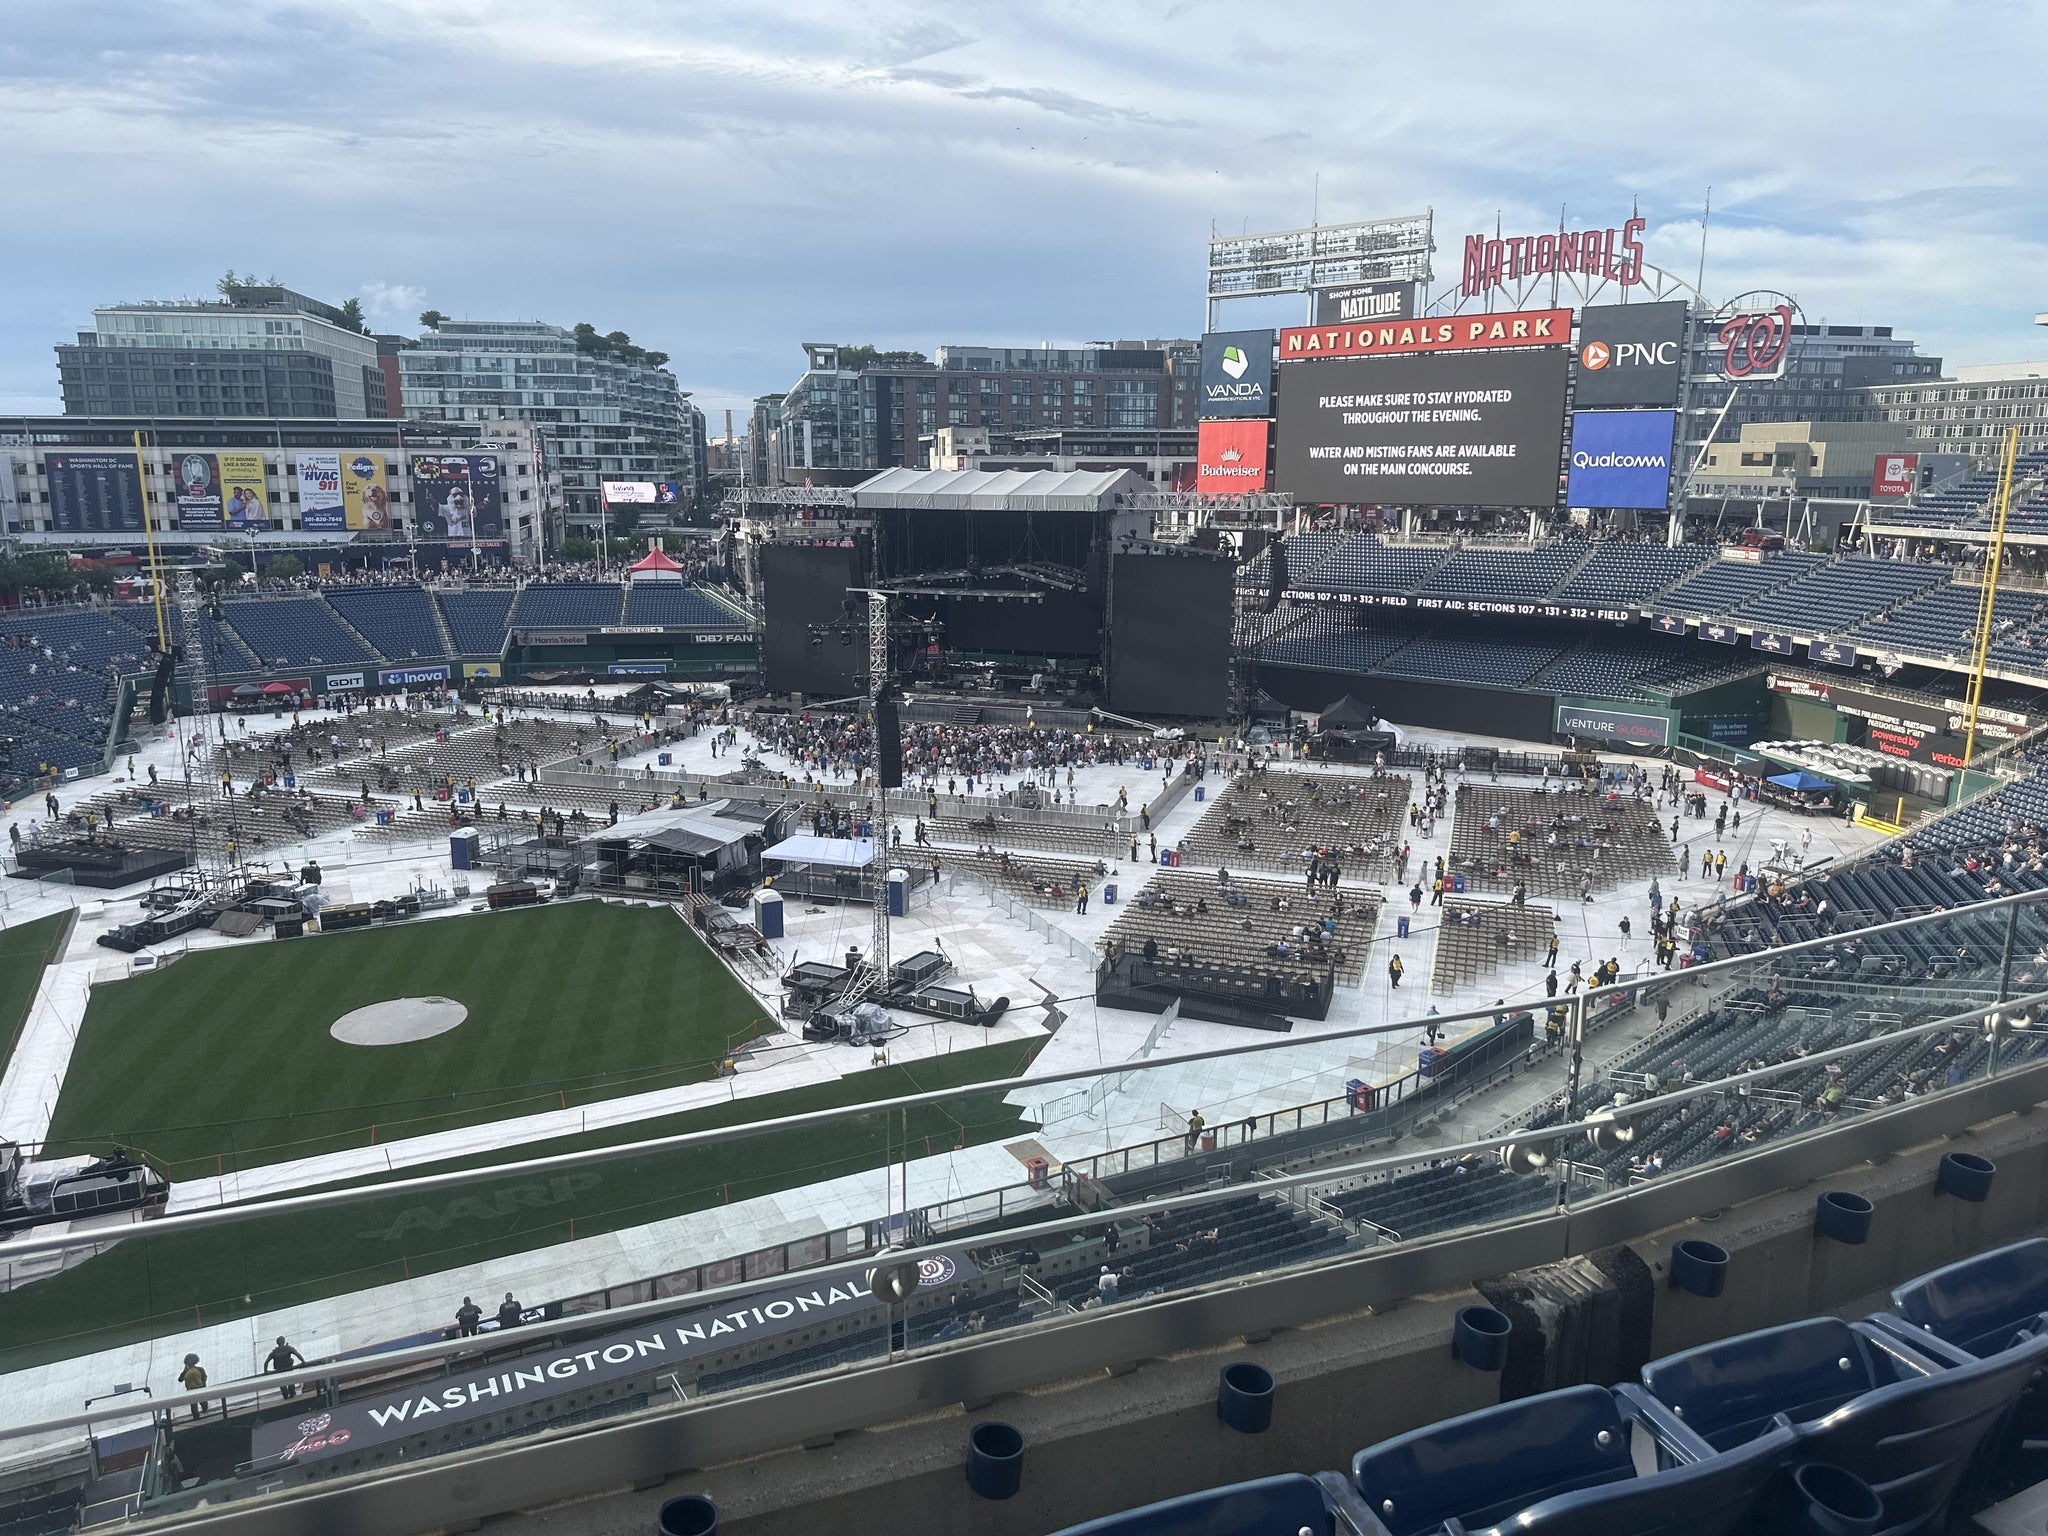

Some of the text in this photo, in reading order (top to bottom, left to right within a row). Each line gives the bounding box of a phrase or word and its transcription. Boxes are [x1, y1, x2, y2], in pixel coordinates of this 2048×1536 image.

[1462, 218, 1646, 297] NATIONALS
[1328, 286, 1373, 300] SHOW SOME
[1340, 291, 1401, 319] NATITUDE
[1288, 318, 1553, 351] NATIONALS PARK
[1614, 340, 1678, 366] PNC
[1206, 382, 1264, 396] VANDA
[1319, 390, 1511, 408] PLEASE MAKE SURE TO STAY HYDRATED
[1343, 409, 1481, 424] THROUGHOUT THE EVENING.
[1310, 445, 1516, 458] WATER AND MISTING FANS ARE AVAILABLE
[346, 463, 378, 471] Pedigree
[1574, 452, 1666, 469] Qualcomm
[305, 472, 338, 480] HVAC
[1201, 464, 1260, 476] Budweiser
[1344, 463, 1472, 475] ON THE MAIN CONCOURSE.
[318, 481, 338, 490] 911
[613, 484, 634, 496] living
[1281, 592, 1407, 606] ECTIONS 107 131 312 FIELD
[1417, 599, 1628, 620] FIRST AID: SECTIONS 107 131 312 FIELD
[726, 634, 752, 642] FAN
[329, 677, 363, 687] GDIT
[404, 671, 442, 683] Inova
[1777, 680, 1810, 689] WASHINGTON
[1790, 687, 1819, 696] NATIONALS
[1994, 710, 2009, 719] EXIT
[1565, 718, 1660, 737] VENTURE GLOBAL
[1872, 730, 1920, 748] powered by
[1879, 741, 1910, 757] Verizon
[368, 1281, 872, 1428] WASHINGTON NATIONAL
